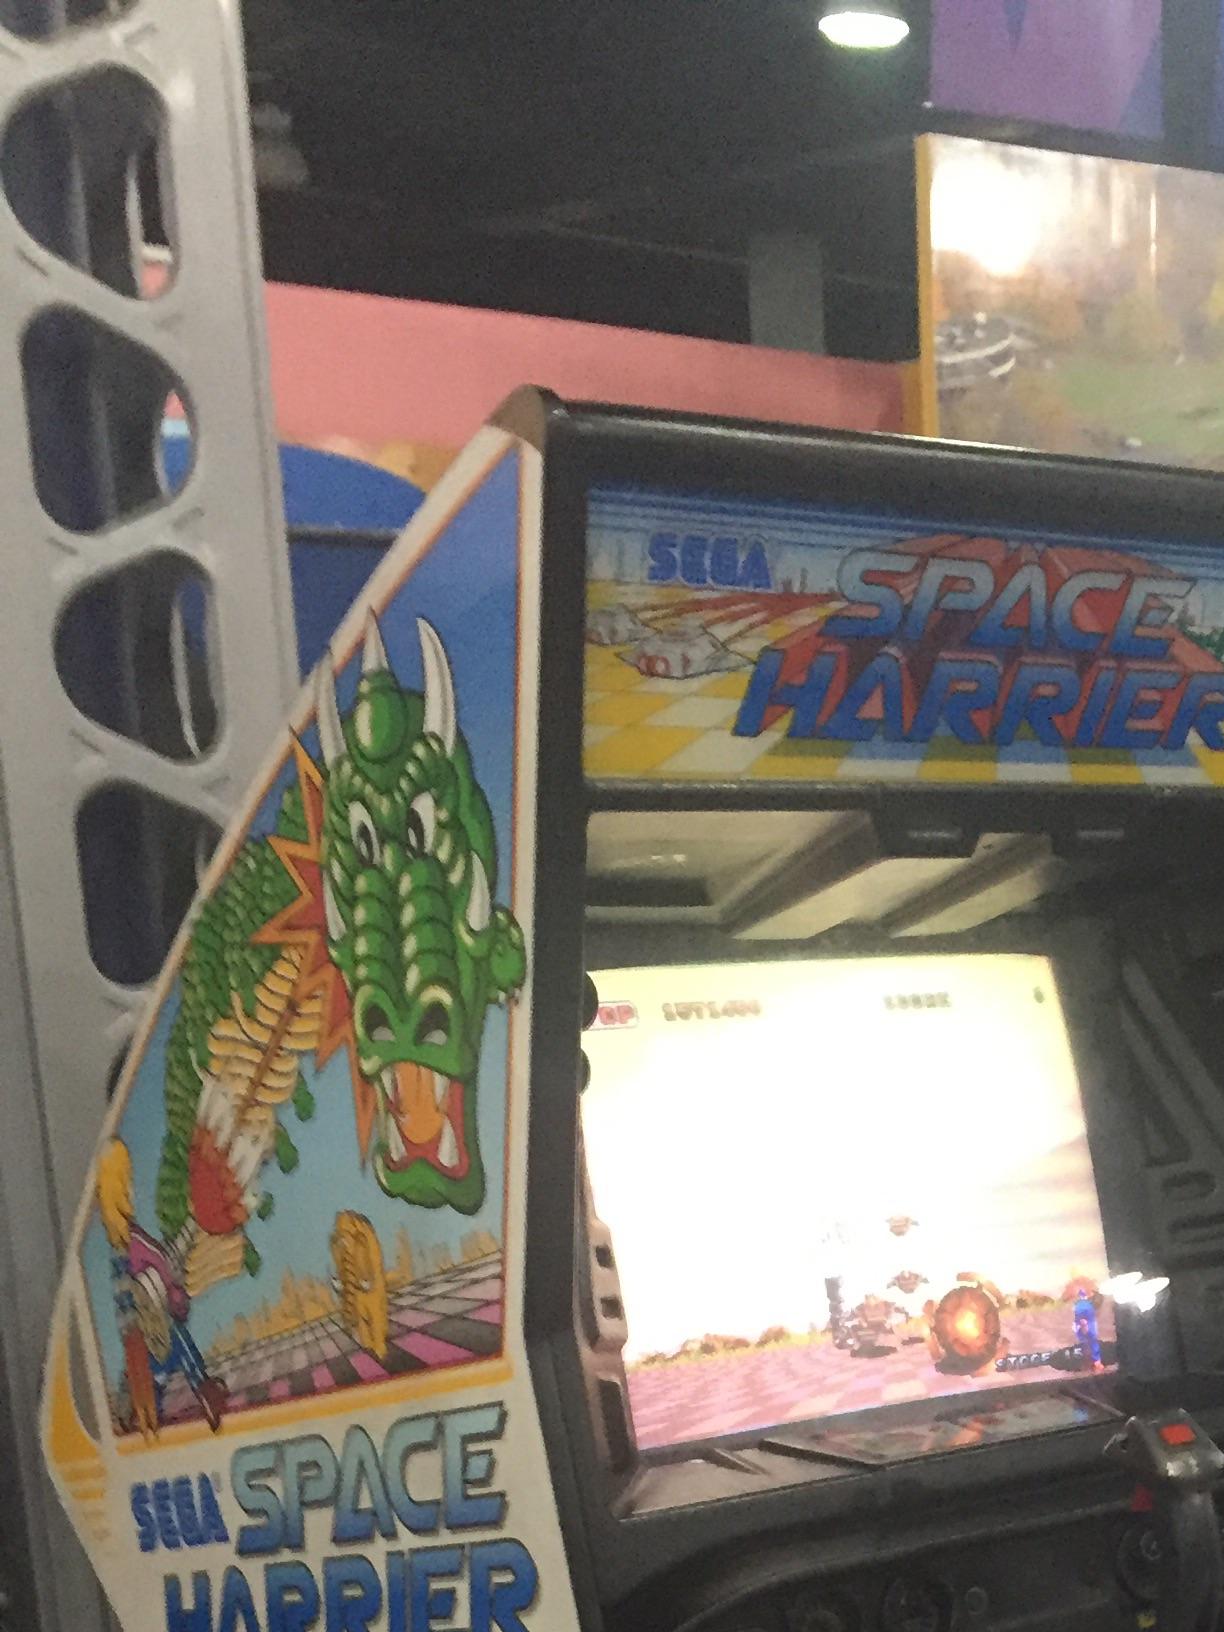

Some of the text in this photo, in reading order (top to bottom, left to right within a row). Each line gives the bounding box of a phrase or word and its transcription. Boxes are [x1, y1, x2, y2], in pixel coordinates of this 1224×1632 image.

[647, 530, 773, 591] SEGA
[819, 543, 1198, 660] SPACE
[130, 1400, 509, 1557] SEGA SPACE
